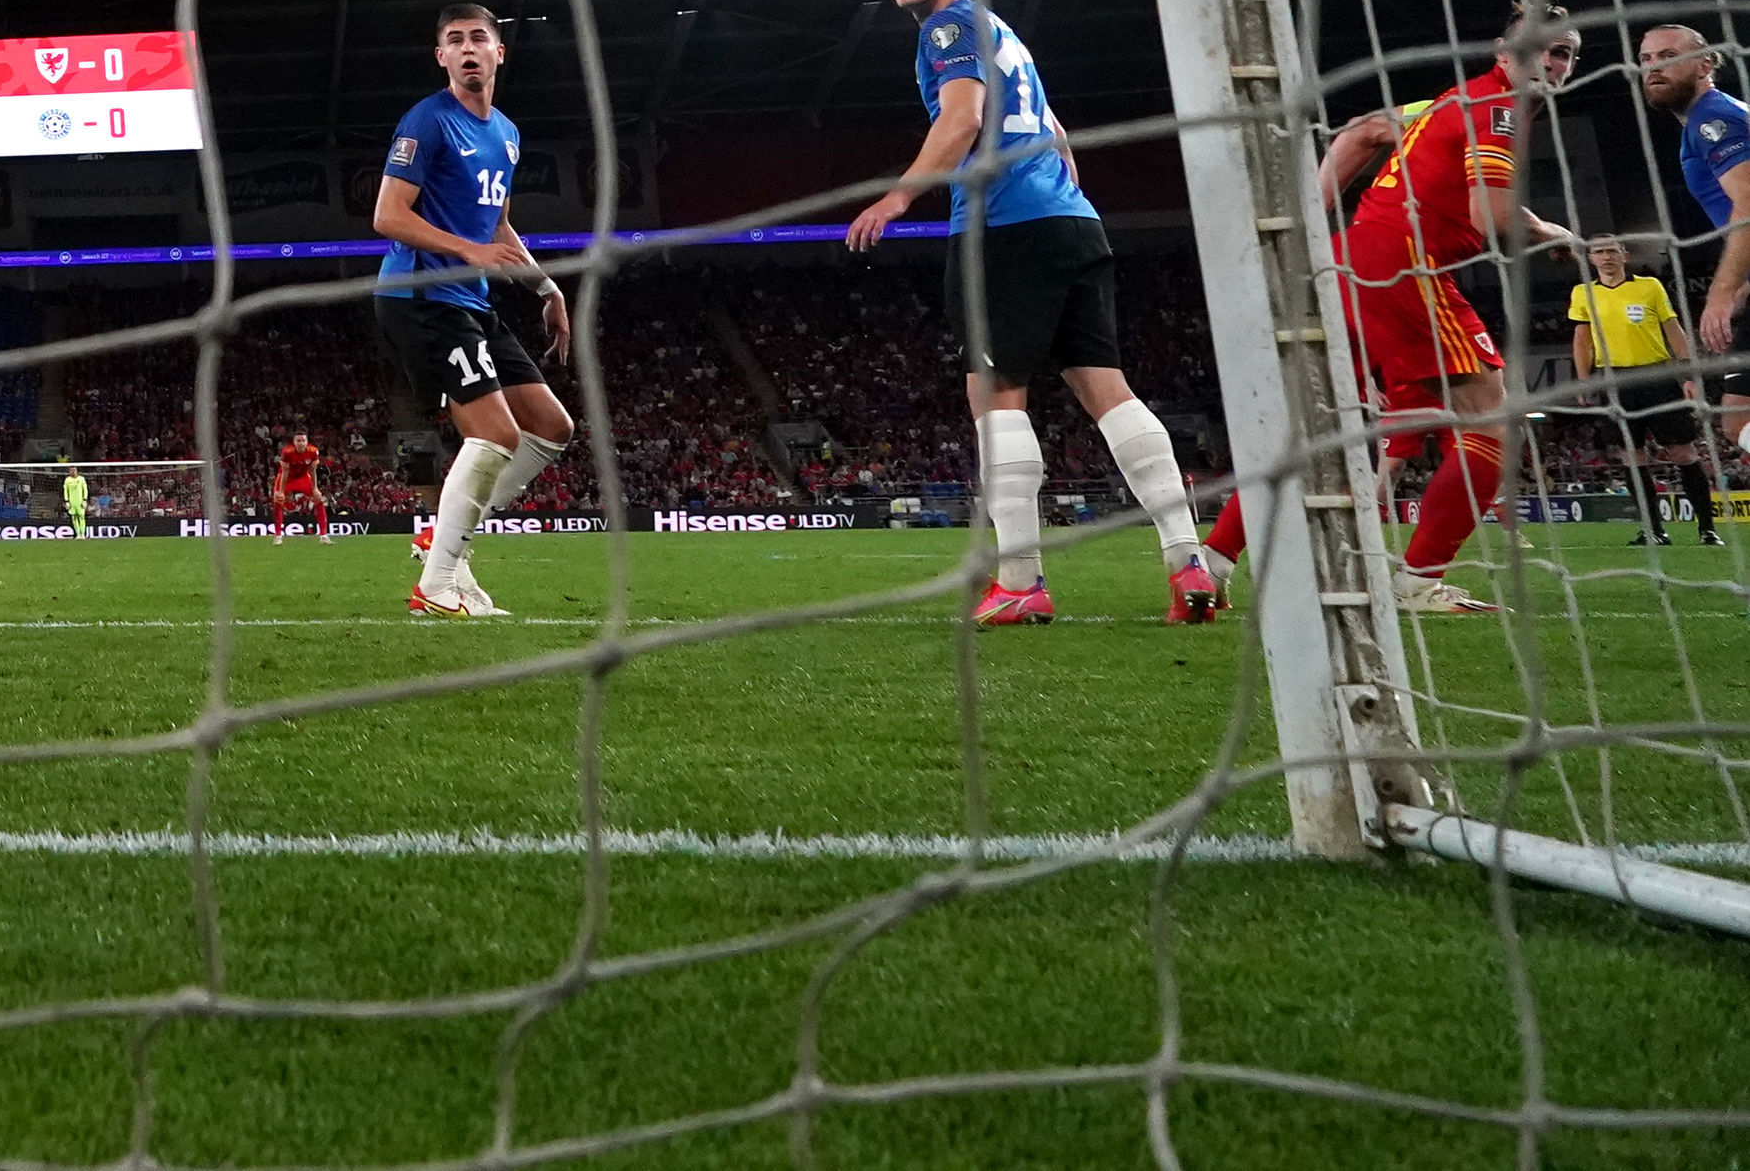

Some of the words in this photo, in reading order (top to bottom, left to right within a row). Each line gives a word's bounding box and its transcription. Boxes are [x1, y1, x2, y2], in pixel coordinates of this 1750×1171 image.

[104, 48, 124, 81] 0
[109, 109, 126, 138] 0
[477, 169, 506, 207] 16
[654, 510, 787, 532] Hisense
